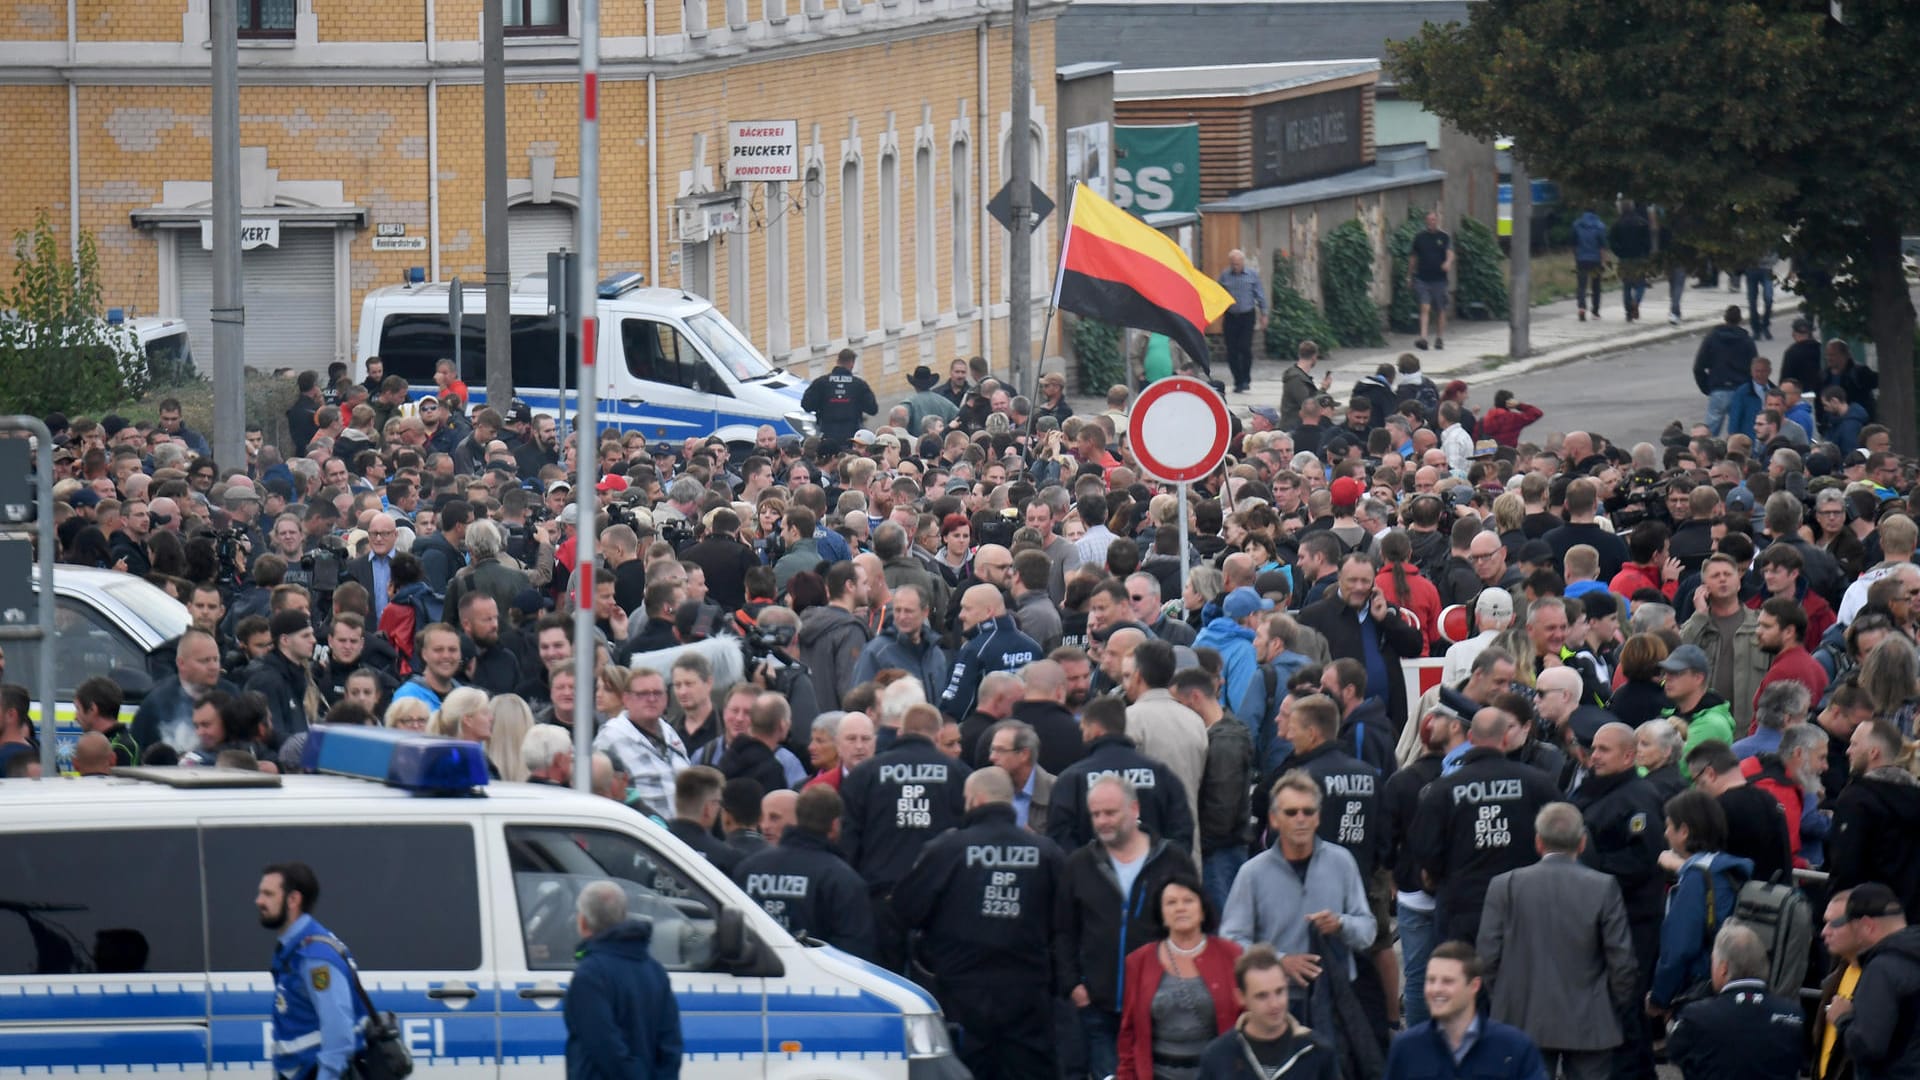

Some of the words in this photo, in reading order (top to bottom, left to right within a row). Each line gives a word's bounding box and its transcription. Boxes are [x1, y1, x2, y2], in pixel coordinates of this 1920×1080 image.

[733, 145, 792, 156] PEUCKERT
[735, 166, 792, 176] KONDITOREI
[1062, 635, 1079, 647] ICH
[1002, 651, 1032, 667] tyco
[880, 763, 948, 783] POLIZEI
[902, 784, 925, 799] BP
[1324, 774, 1374, 796] POLIZEI
[1453, 779, 1522, 806] POLIZEI
[897, 798, 930, 812] BLU
[1345, 800, 1362, 815] BP
[1479, 804, 1502, 820] BP
[896, 812, 931, 828] 3160
[1340, 813, 1365, 828] BLU
[1475, 817, 1509, 834] BLU
[1338, 827, 1365, 843] 3160
[1474, 831, 1511, 849] 3160
[966, 845, 1040, 869] POLIZEI
[746, 873, 809, 897] POLIZEI
[992, 871, 1017, 886] BP
[984, 885, 1021, 901] BLU
[982, 900, 1021, 917] 3230
